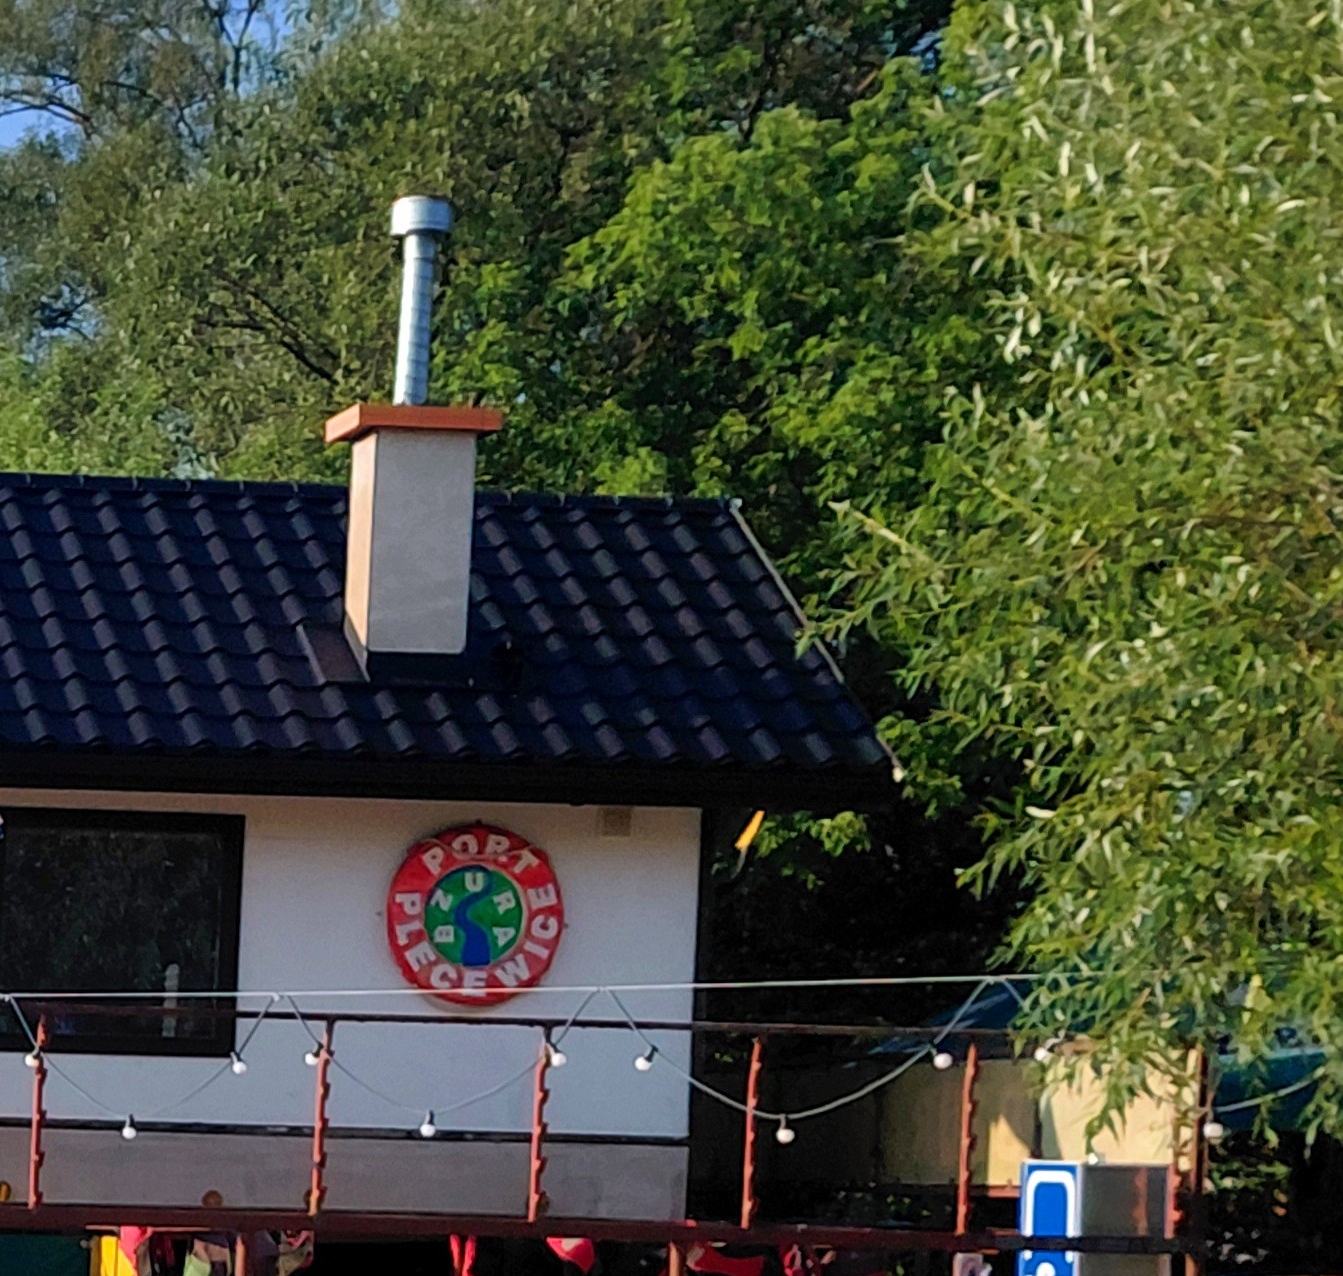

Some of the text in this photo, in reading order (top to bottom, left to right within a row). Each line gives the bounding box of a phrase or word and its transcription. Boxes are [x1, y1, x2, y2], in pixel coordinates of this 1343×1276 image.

[422, 834, 540, 875] PORT
[394, 884, 559, 997] PLECEWICE
[430, 872, 517, 947] BZURA
